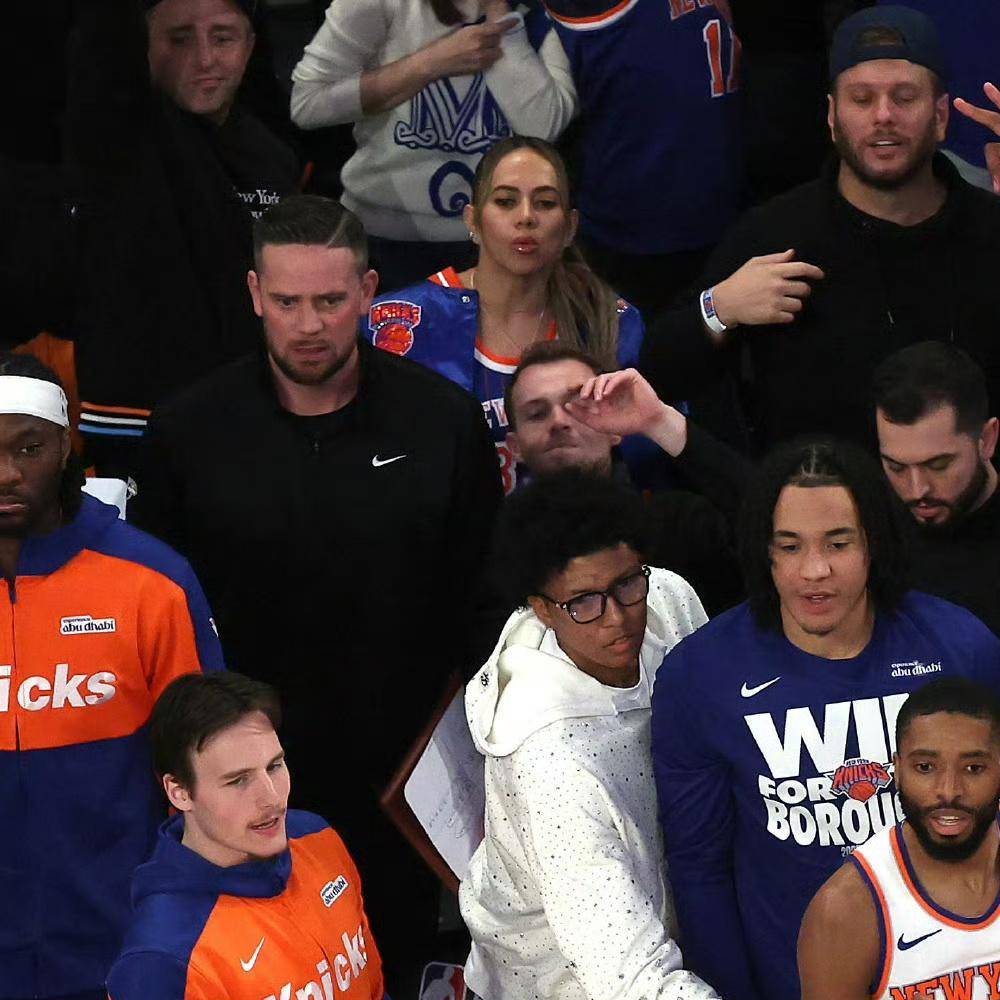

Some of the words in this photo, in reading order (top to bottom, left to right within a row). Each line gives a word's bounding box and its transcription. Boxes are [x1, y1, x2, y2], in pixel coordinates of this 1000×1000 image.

[62, 623, 83, 632] abu
[84, 620, 114, 632] dhabi
[891, 667, 911, 677] abu
[911, 661, 942, 676] dhabi
[758, 774, 837, 805] FOR
[831, 761, 890, 791] KNICKS
[763, 791, 906, 846] BOROU
